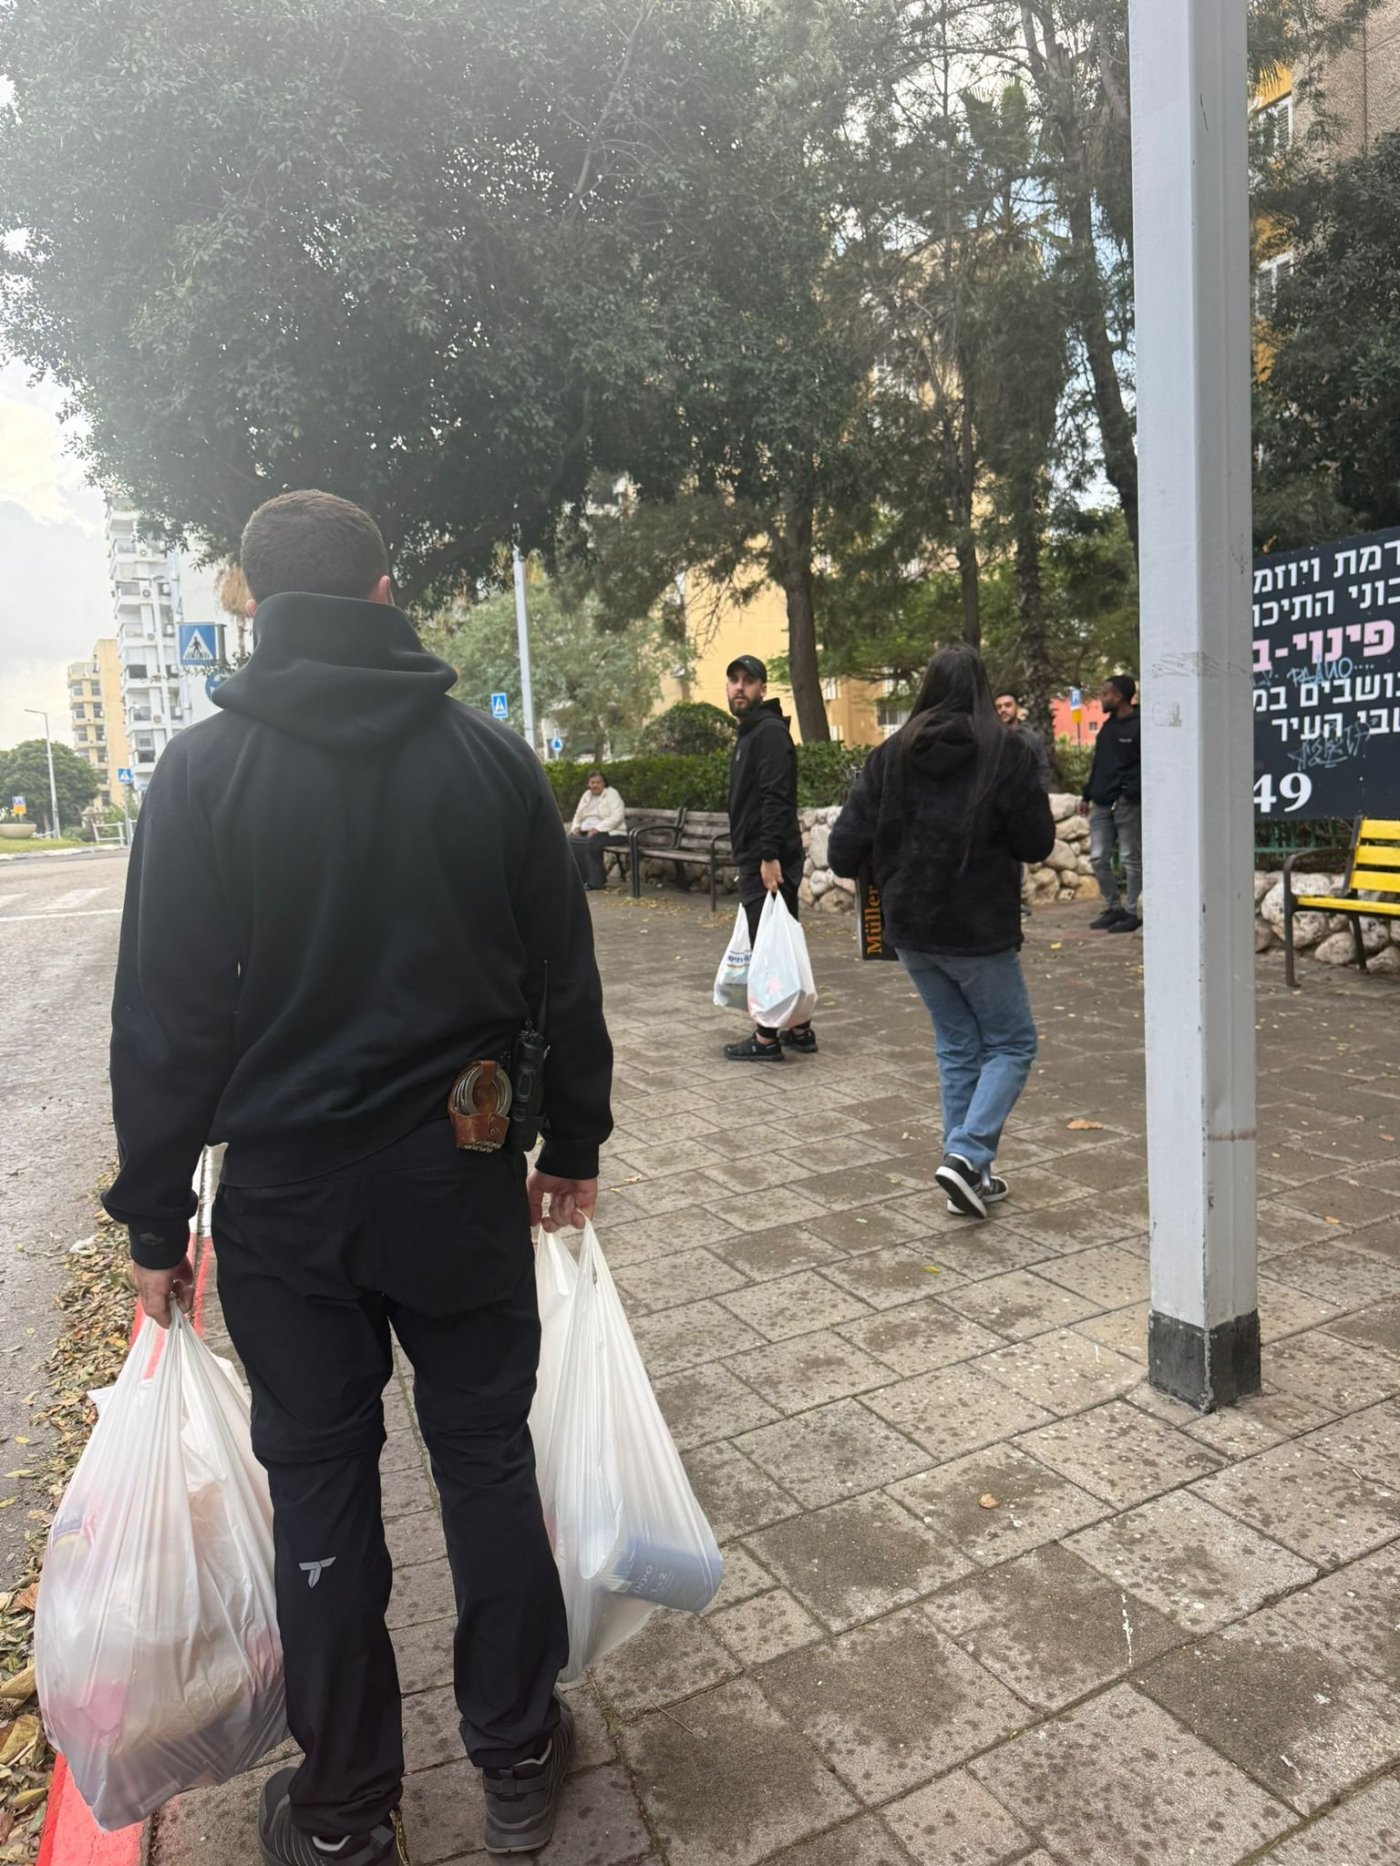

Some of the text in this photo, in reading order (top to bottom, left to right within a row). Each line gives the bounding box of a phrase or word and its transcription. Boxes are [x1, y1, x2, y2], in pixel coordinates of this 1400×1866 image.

[1300, 671, 1400, 708] ושבים
[1271, 712, 1343, 742] העיר
[1253, 772, 1312, 813] 49
[864, 884, 882, 955] Müller
